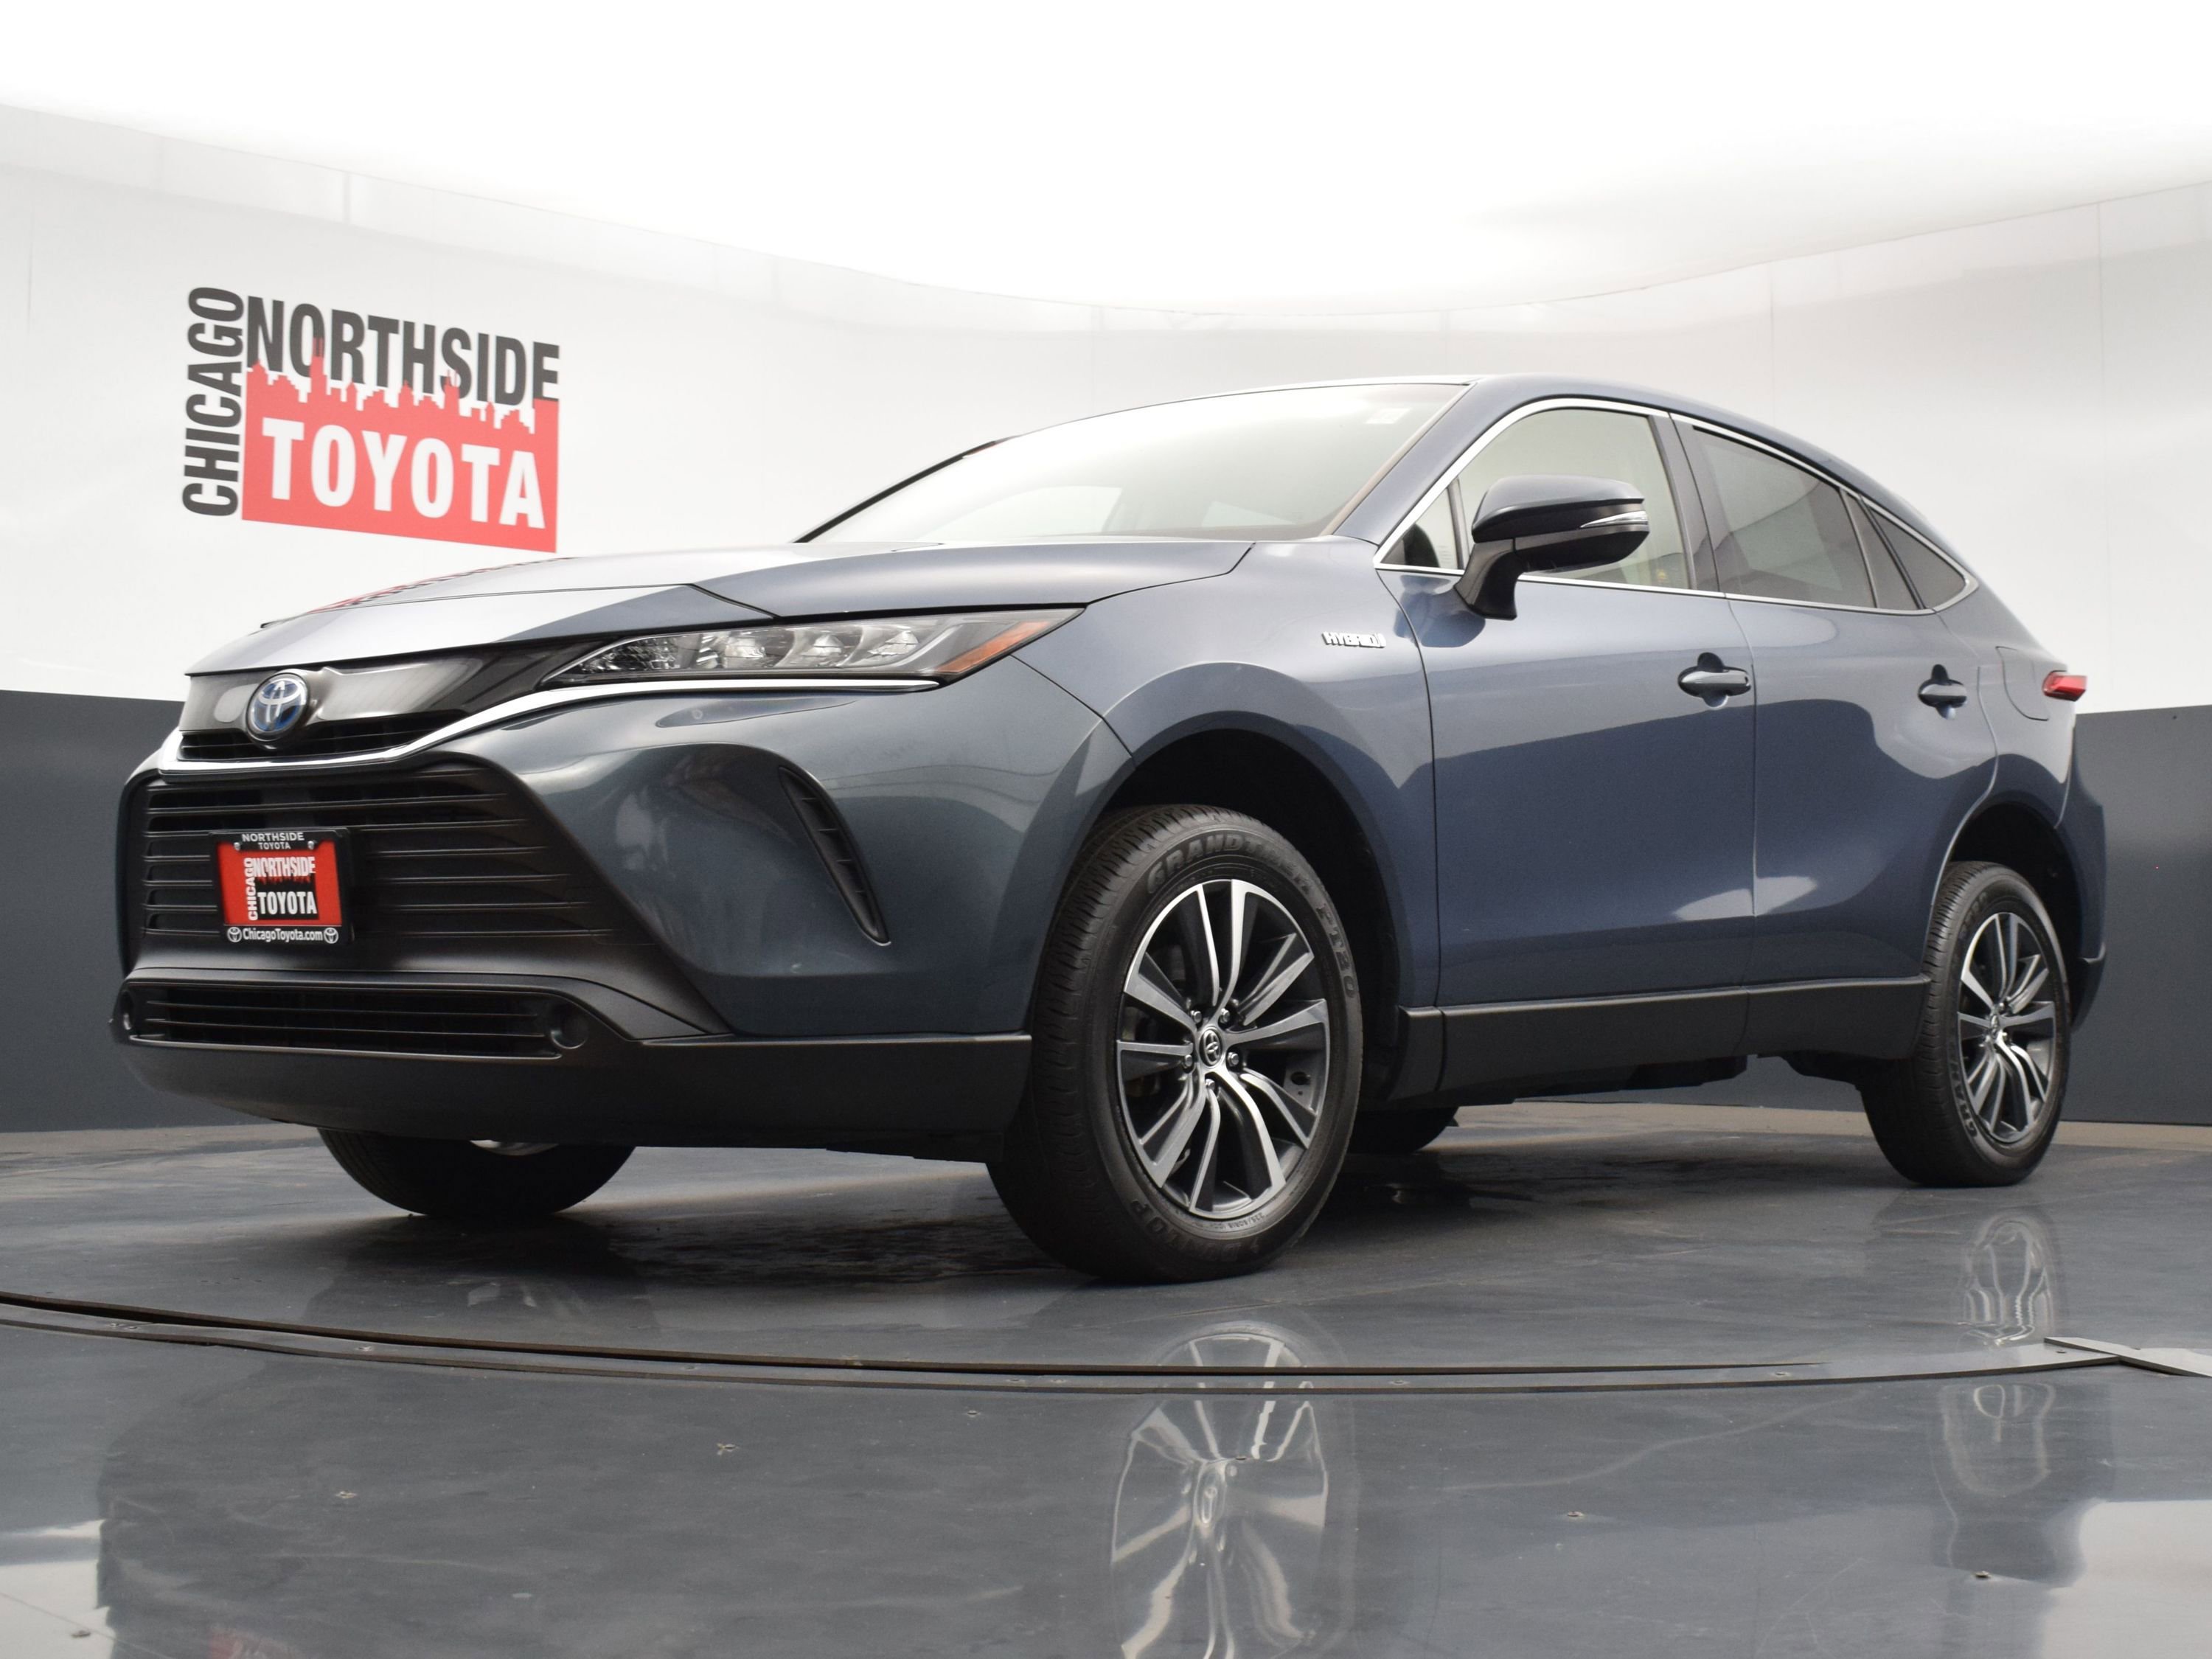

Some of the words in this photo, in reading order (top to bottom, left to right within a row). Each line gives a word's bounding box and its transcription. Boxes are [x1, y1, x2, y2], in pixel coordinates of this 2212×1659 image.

[246, 295, 560, 406] NORTHSIDE
[182, 287, 244, 516] CHICAGO
[262, 417, 546, 529] TOYOTA
[1321, 632, 1385, 649] HYBRID
[241, 832, 305, 842] NORTHSIDE
[258, 842, 291, 850] TOYOTA
[253, 857, 316, 877] NORTHSIDE
[243, 858, 258, 921] CHICAGO
[257, 891, 318, 915] TOYOTA
[243, 928, 323, 943] ChicagoToyota.com
